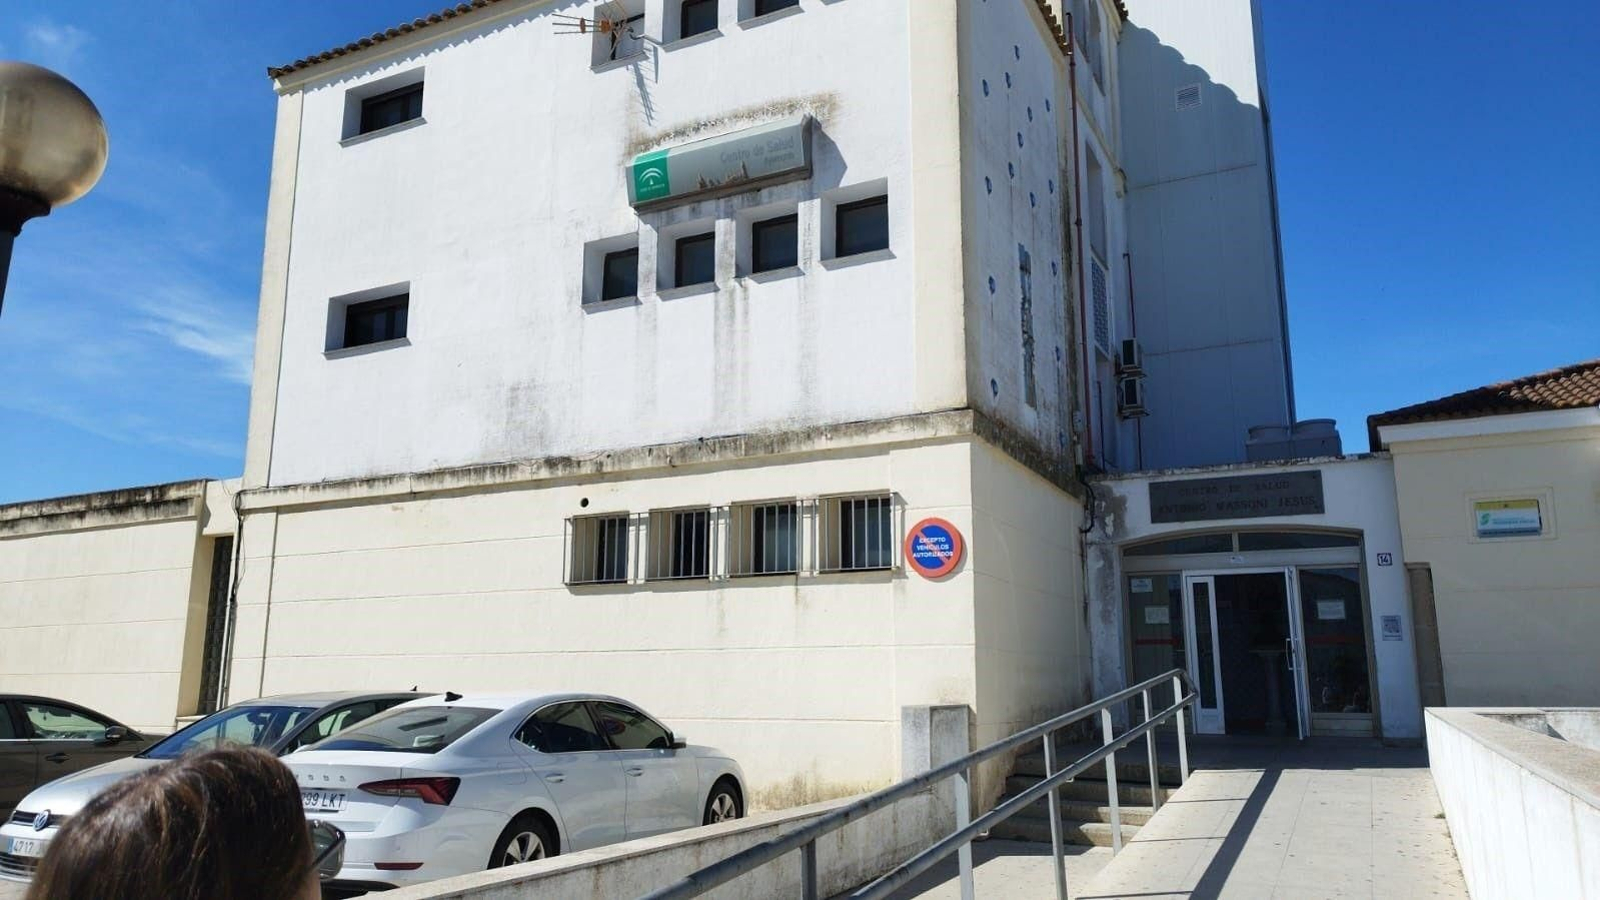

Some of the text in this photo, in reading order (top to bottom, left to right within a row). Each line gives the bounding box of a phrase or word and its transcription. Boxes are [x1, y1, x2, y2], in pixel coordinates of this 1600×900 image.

[720, 149, 750, 163] Centro
[753, 143, 765, 157] de
[767, 135, 794, 152] Salud
[1277, 495, 1316, 508] JESUS
[919, 536, 947, 544] EXCEPTO
[321, 792, 346, 808] LKT
